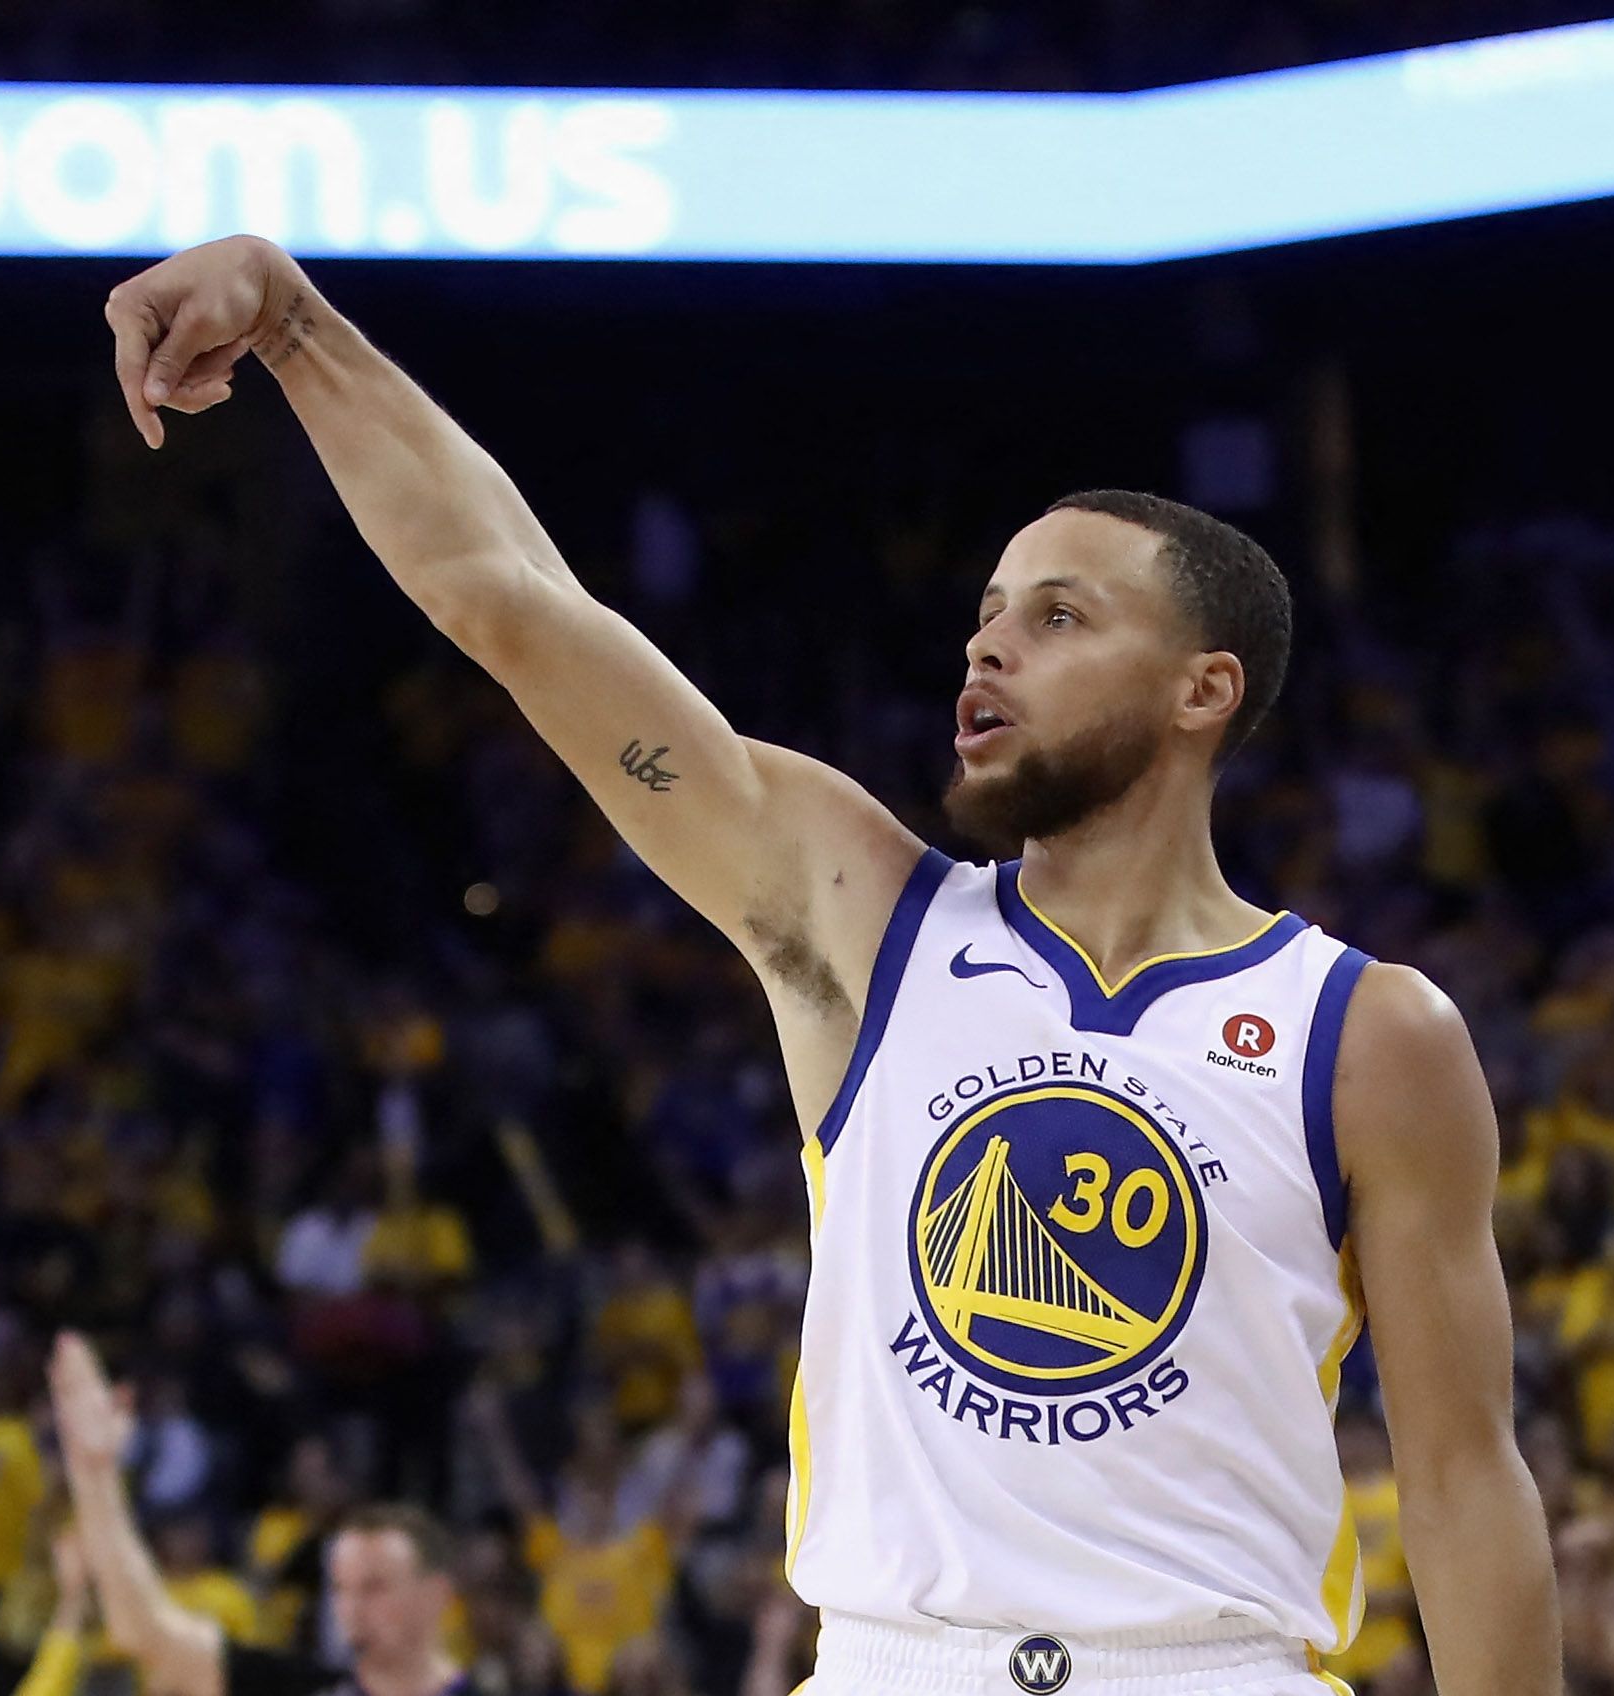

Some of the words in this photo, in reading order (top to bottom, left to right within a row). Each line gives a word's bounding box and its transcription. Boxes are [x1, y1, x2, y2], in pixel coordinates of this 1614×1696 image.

[1206, 1050, 1277, 1078] Rakuten
[1236, 1020, 1261, 1052] R
[928, 1052, 1108, 1121] GOLDEN
[1123, 1075, 1229, 1187] STATE
[1048, 1152, 1170, 1249] 30
[889, 1311, 1189, 1445] WARRIORS
[1015, 1649, 1065, 1684] W
